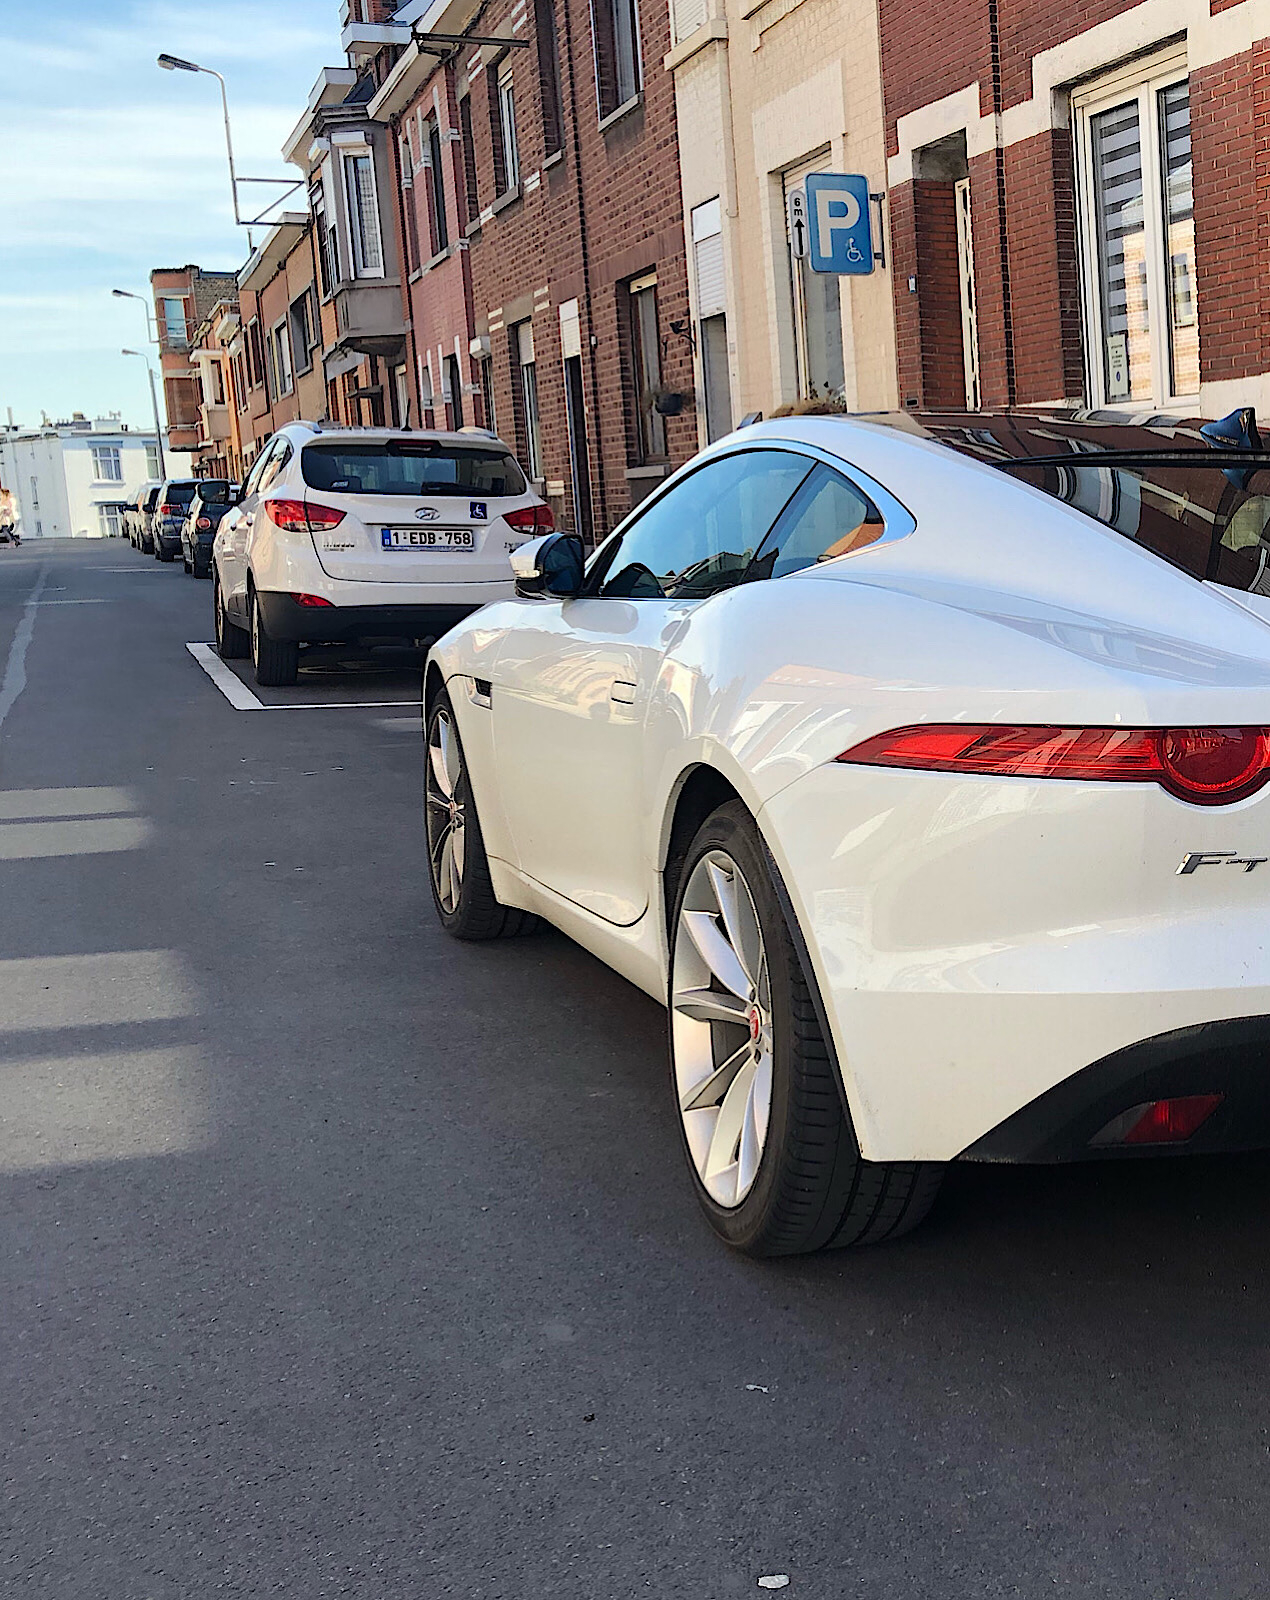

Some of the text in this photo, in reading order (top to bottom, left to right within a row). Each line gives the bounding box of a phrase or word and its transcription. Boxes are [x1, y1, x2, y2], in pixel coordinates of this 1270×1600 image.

[794, 197, 801, 207] 6
[794, 208, 803, 216] m
[815, 189, 861, 258] P
